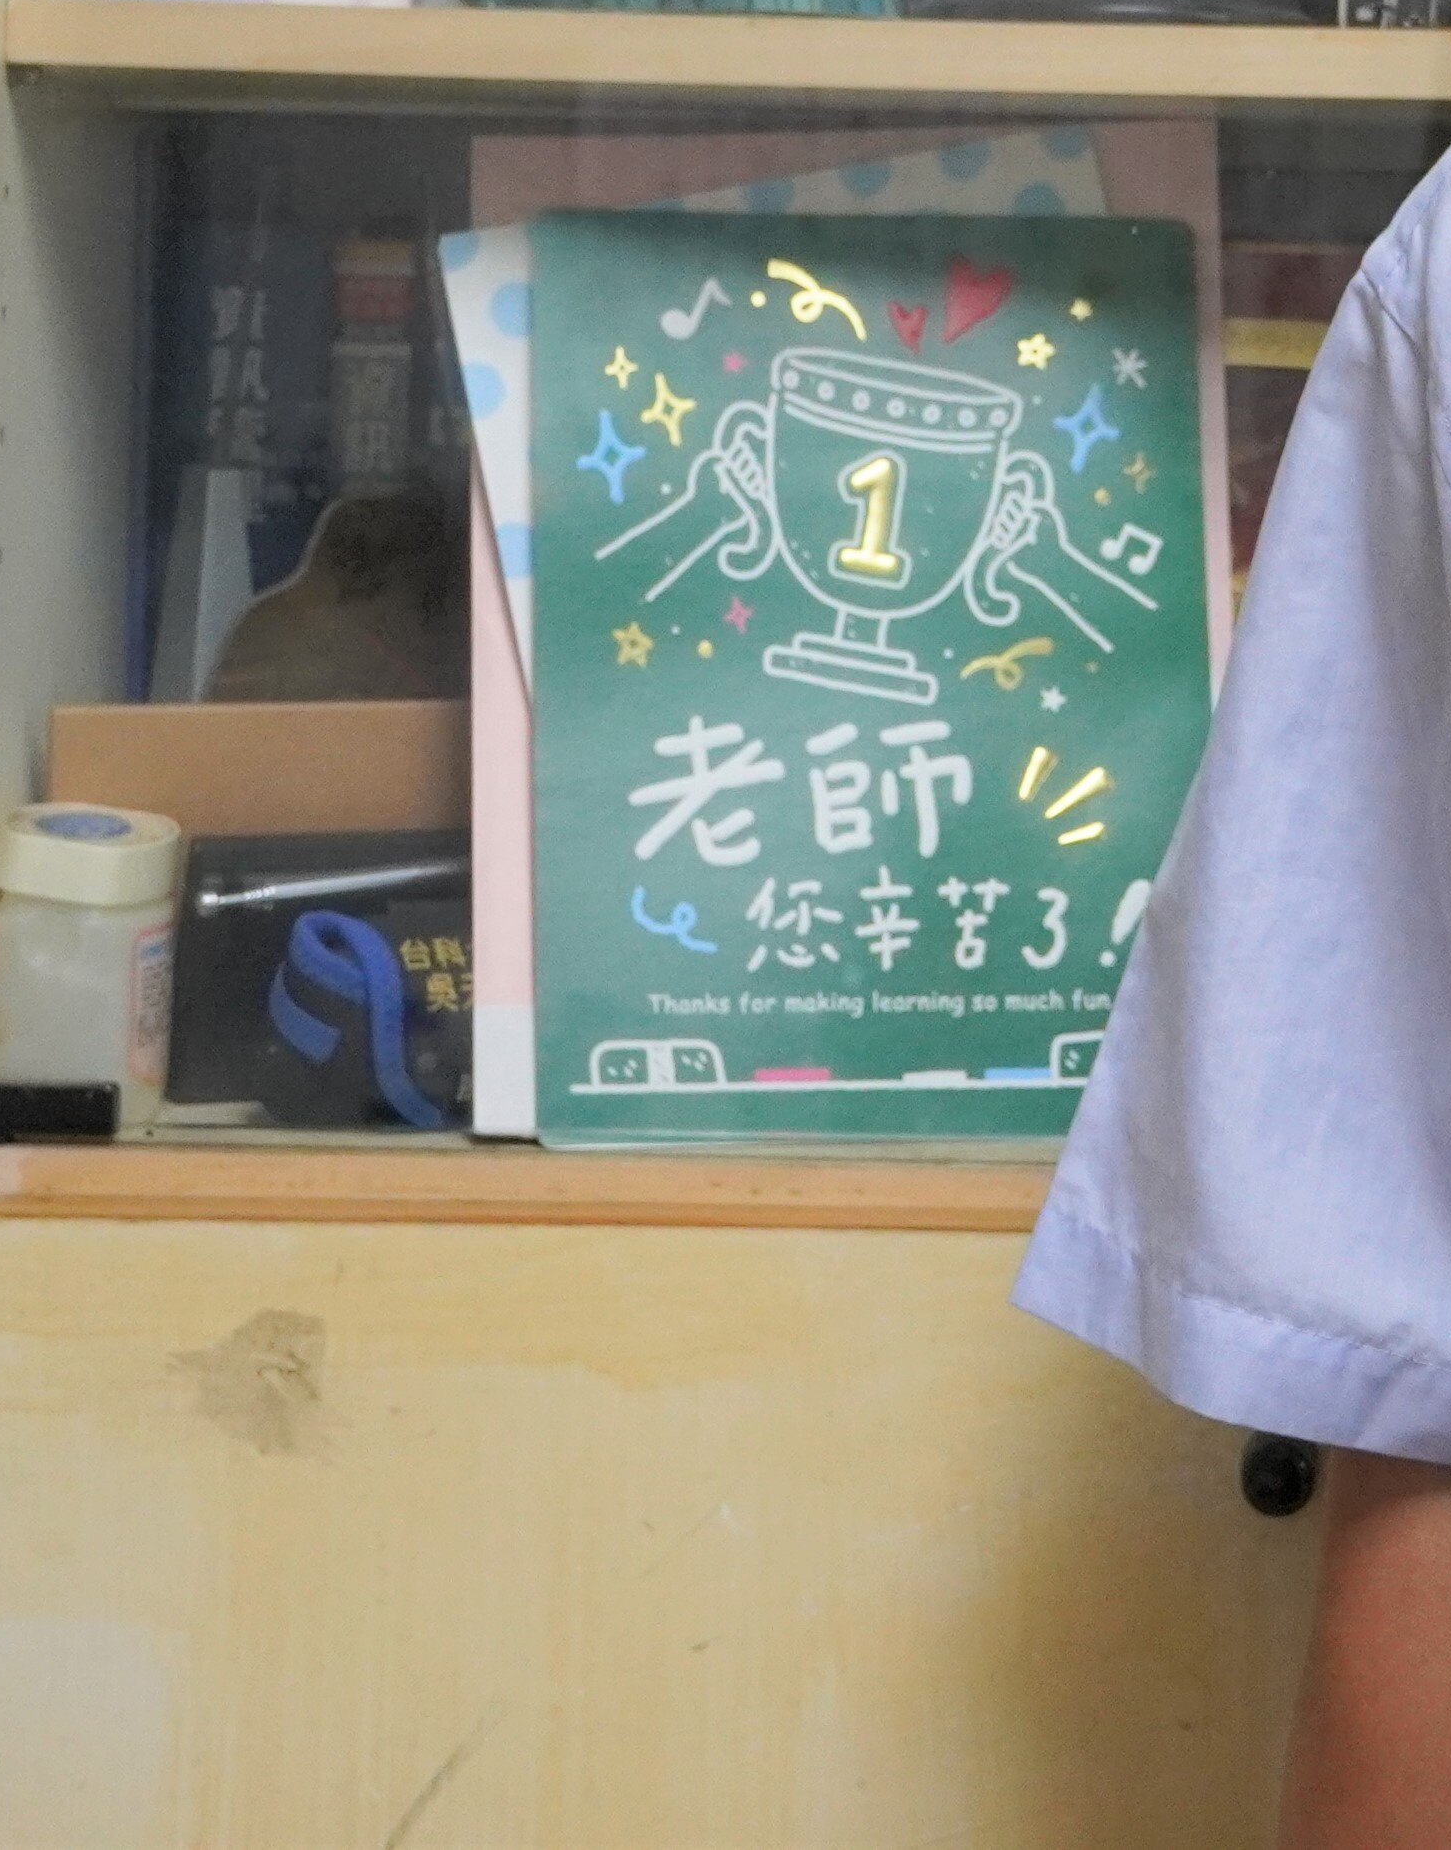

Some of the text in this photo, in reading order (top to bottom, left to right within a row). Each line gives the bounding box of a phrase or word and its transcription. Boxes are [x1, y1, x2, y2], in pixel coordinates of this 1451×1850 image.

[834, 456, 902, 576] 1
[629, 716, 972, 867] 老師
[648, 993, 730, 1015] Thanks
[740, 992, 775, 1014] for
[784, 992, 864, 1018] making
[872, 990, 965, 1017] learning
[971, 997, 997, 1013] so
[1005, 991, 1065, 1013] much
